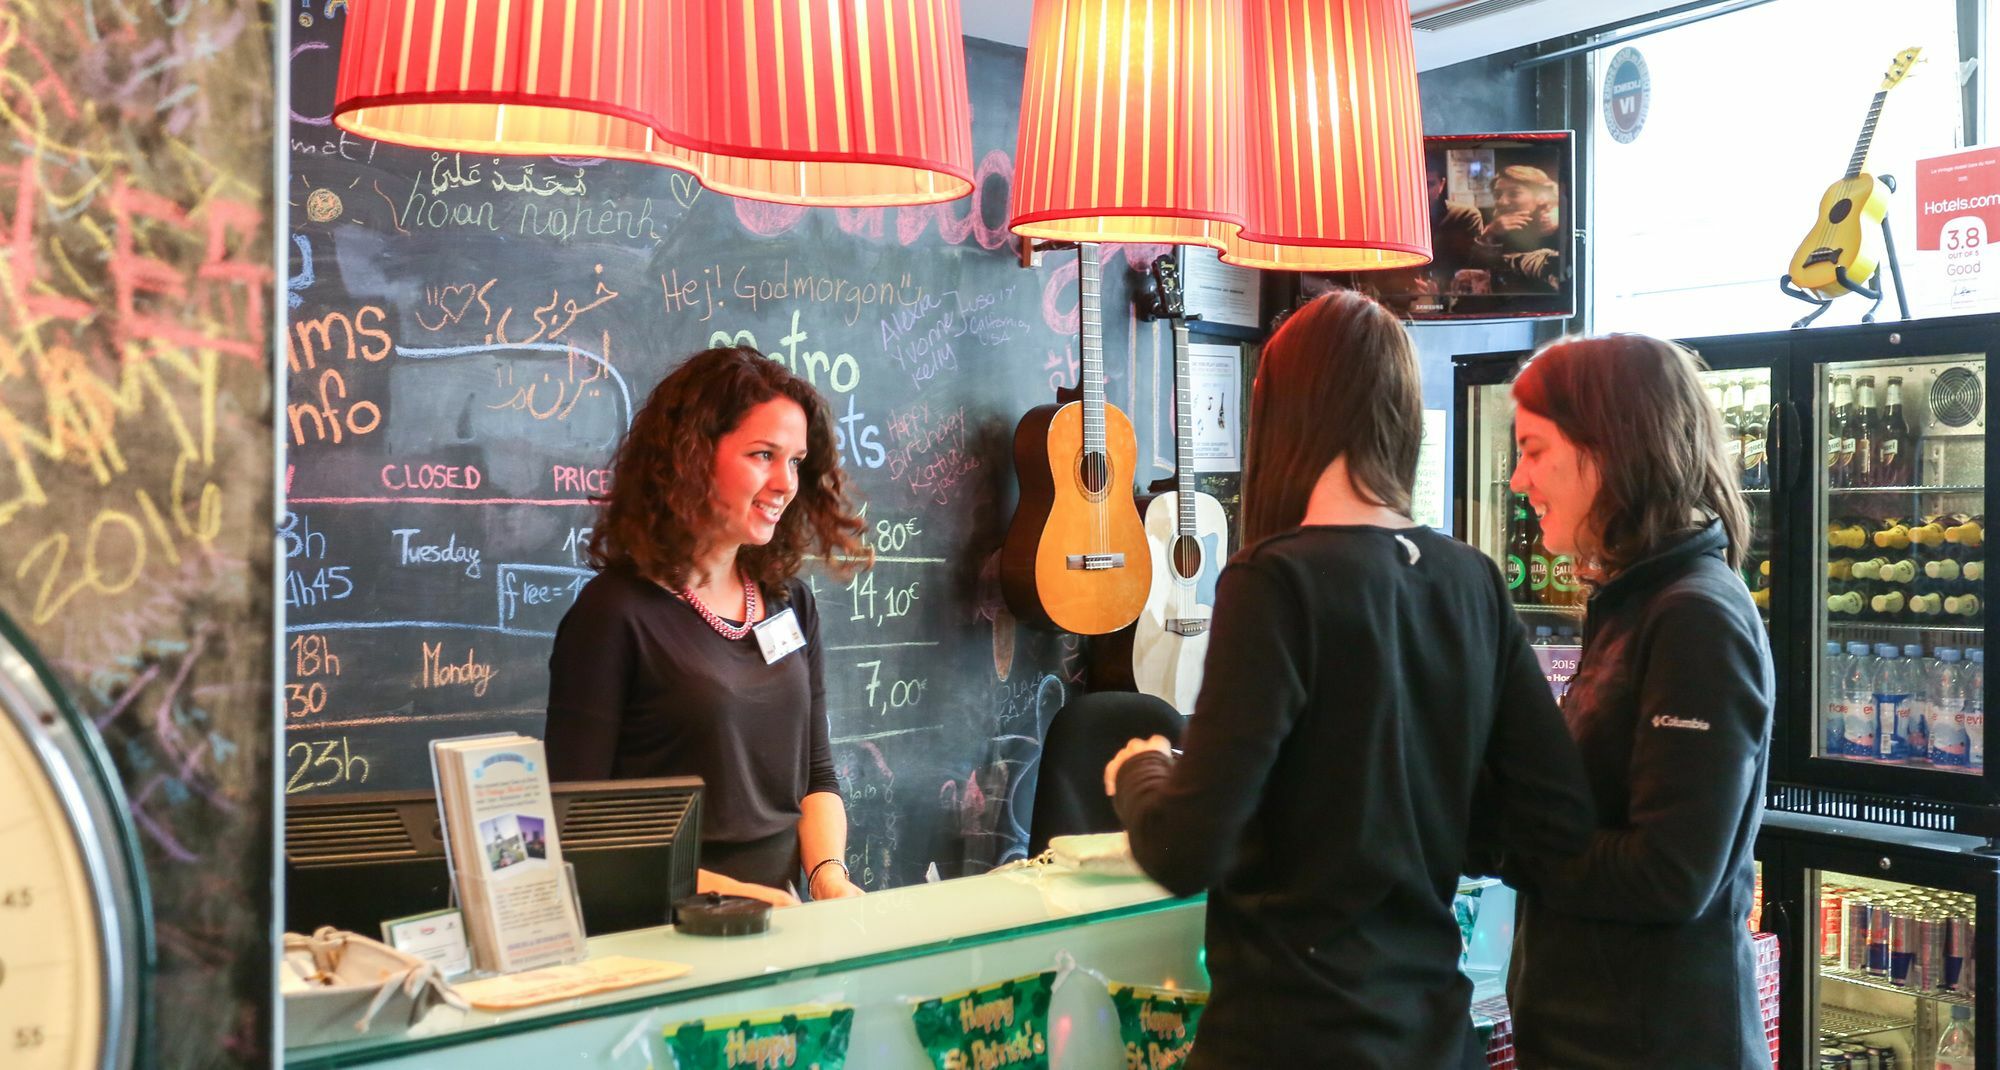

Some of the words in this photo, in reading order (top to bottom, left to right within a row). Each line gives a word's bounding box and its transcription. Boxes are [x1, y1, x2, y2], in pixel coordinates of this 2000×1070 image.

[1924, 193, 2000, 216] Hotels.com
[1947, 227, 1980, 250] 3.8
[1948, 250, 1962, 260] OUT
[1964, 249, 1973, 258] OF
[1946, 260, 1981, 277] Good
[661, 263, 725, 322] Hej!
[381, 464, 481, 492] CLOSED
[553, 465, 611, 495] PRICE
[15, 452, 222, 627] 2016
[391, 528, 481, 579] Tuesday
[290, 634, 340, 677] 18h
[422, 641, 499, 698] Monday
[1551, 659, 1576, 670] 2015
[284, 682, 328, 718] 30
[1660, 715, 1710, 730] Columbia
[285, 737, 369, 795] 23h
[958, 996, 1015, 1034] Happy
[1139, 1001, 1186, 1040] Happy
[724, 1018, 798, 1070] Happy
